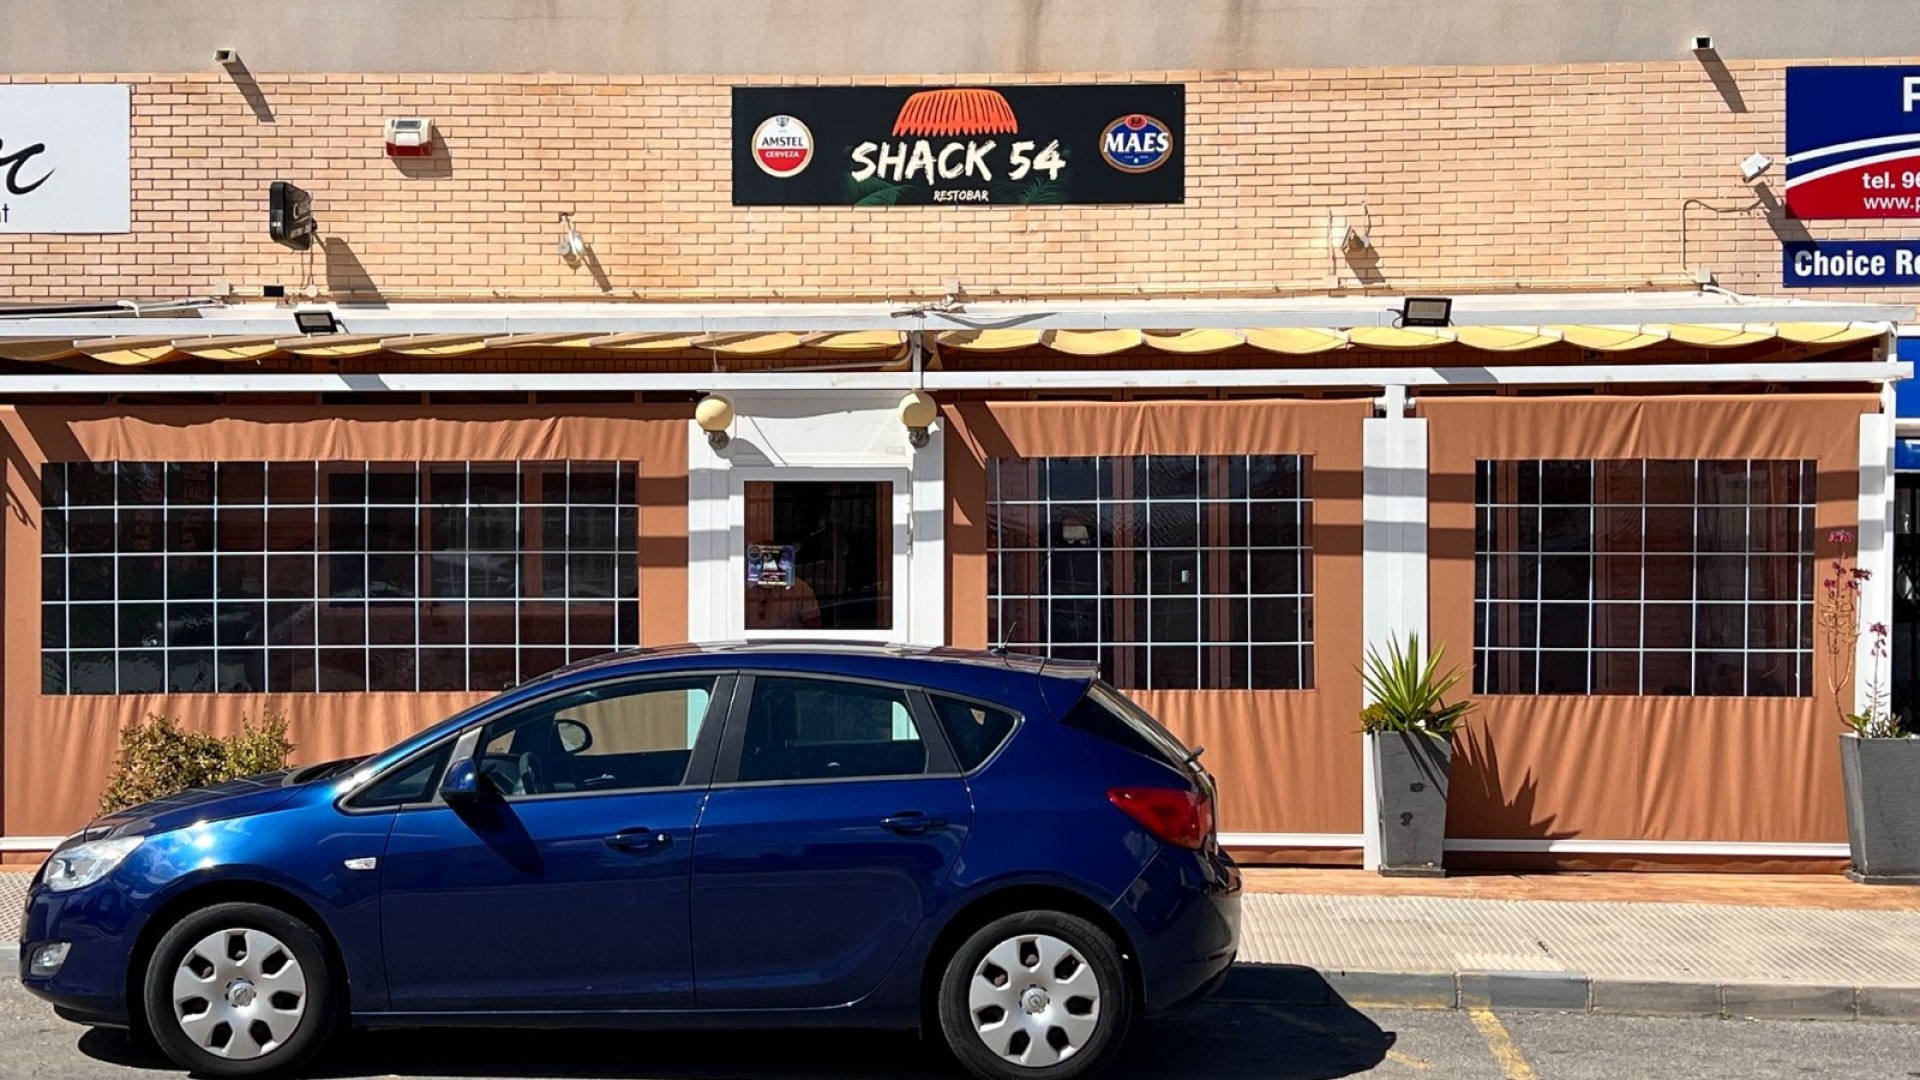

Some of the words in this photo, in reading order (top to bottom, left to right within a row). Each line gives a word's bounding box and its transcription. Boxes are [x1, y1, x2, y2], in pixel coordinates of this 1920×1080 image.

[762, 136, 804, 146] AMSTEL
[1103, 132, 1170, 153] MAES
[765, 150, 799, 158] CERVEZA
[851, 139, 996, 186] SHACK
[1007, 139, 1066, 181] 54
[1862, 171, 1896, 189] tel.
[933, 190, 990, 202] RESTOBAR
[1794, 249, 1886, 277] Choice
